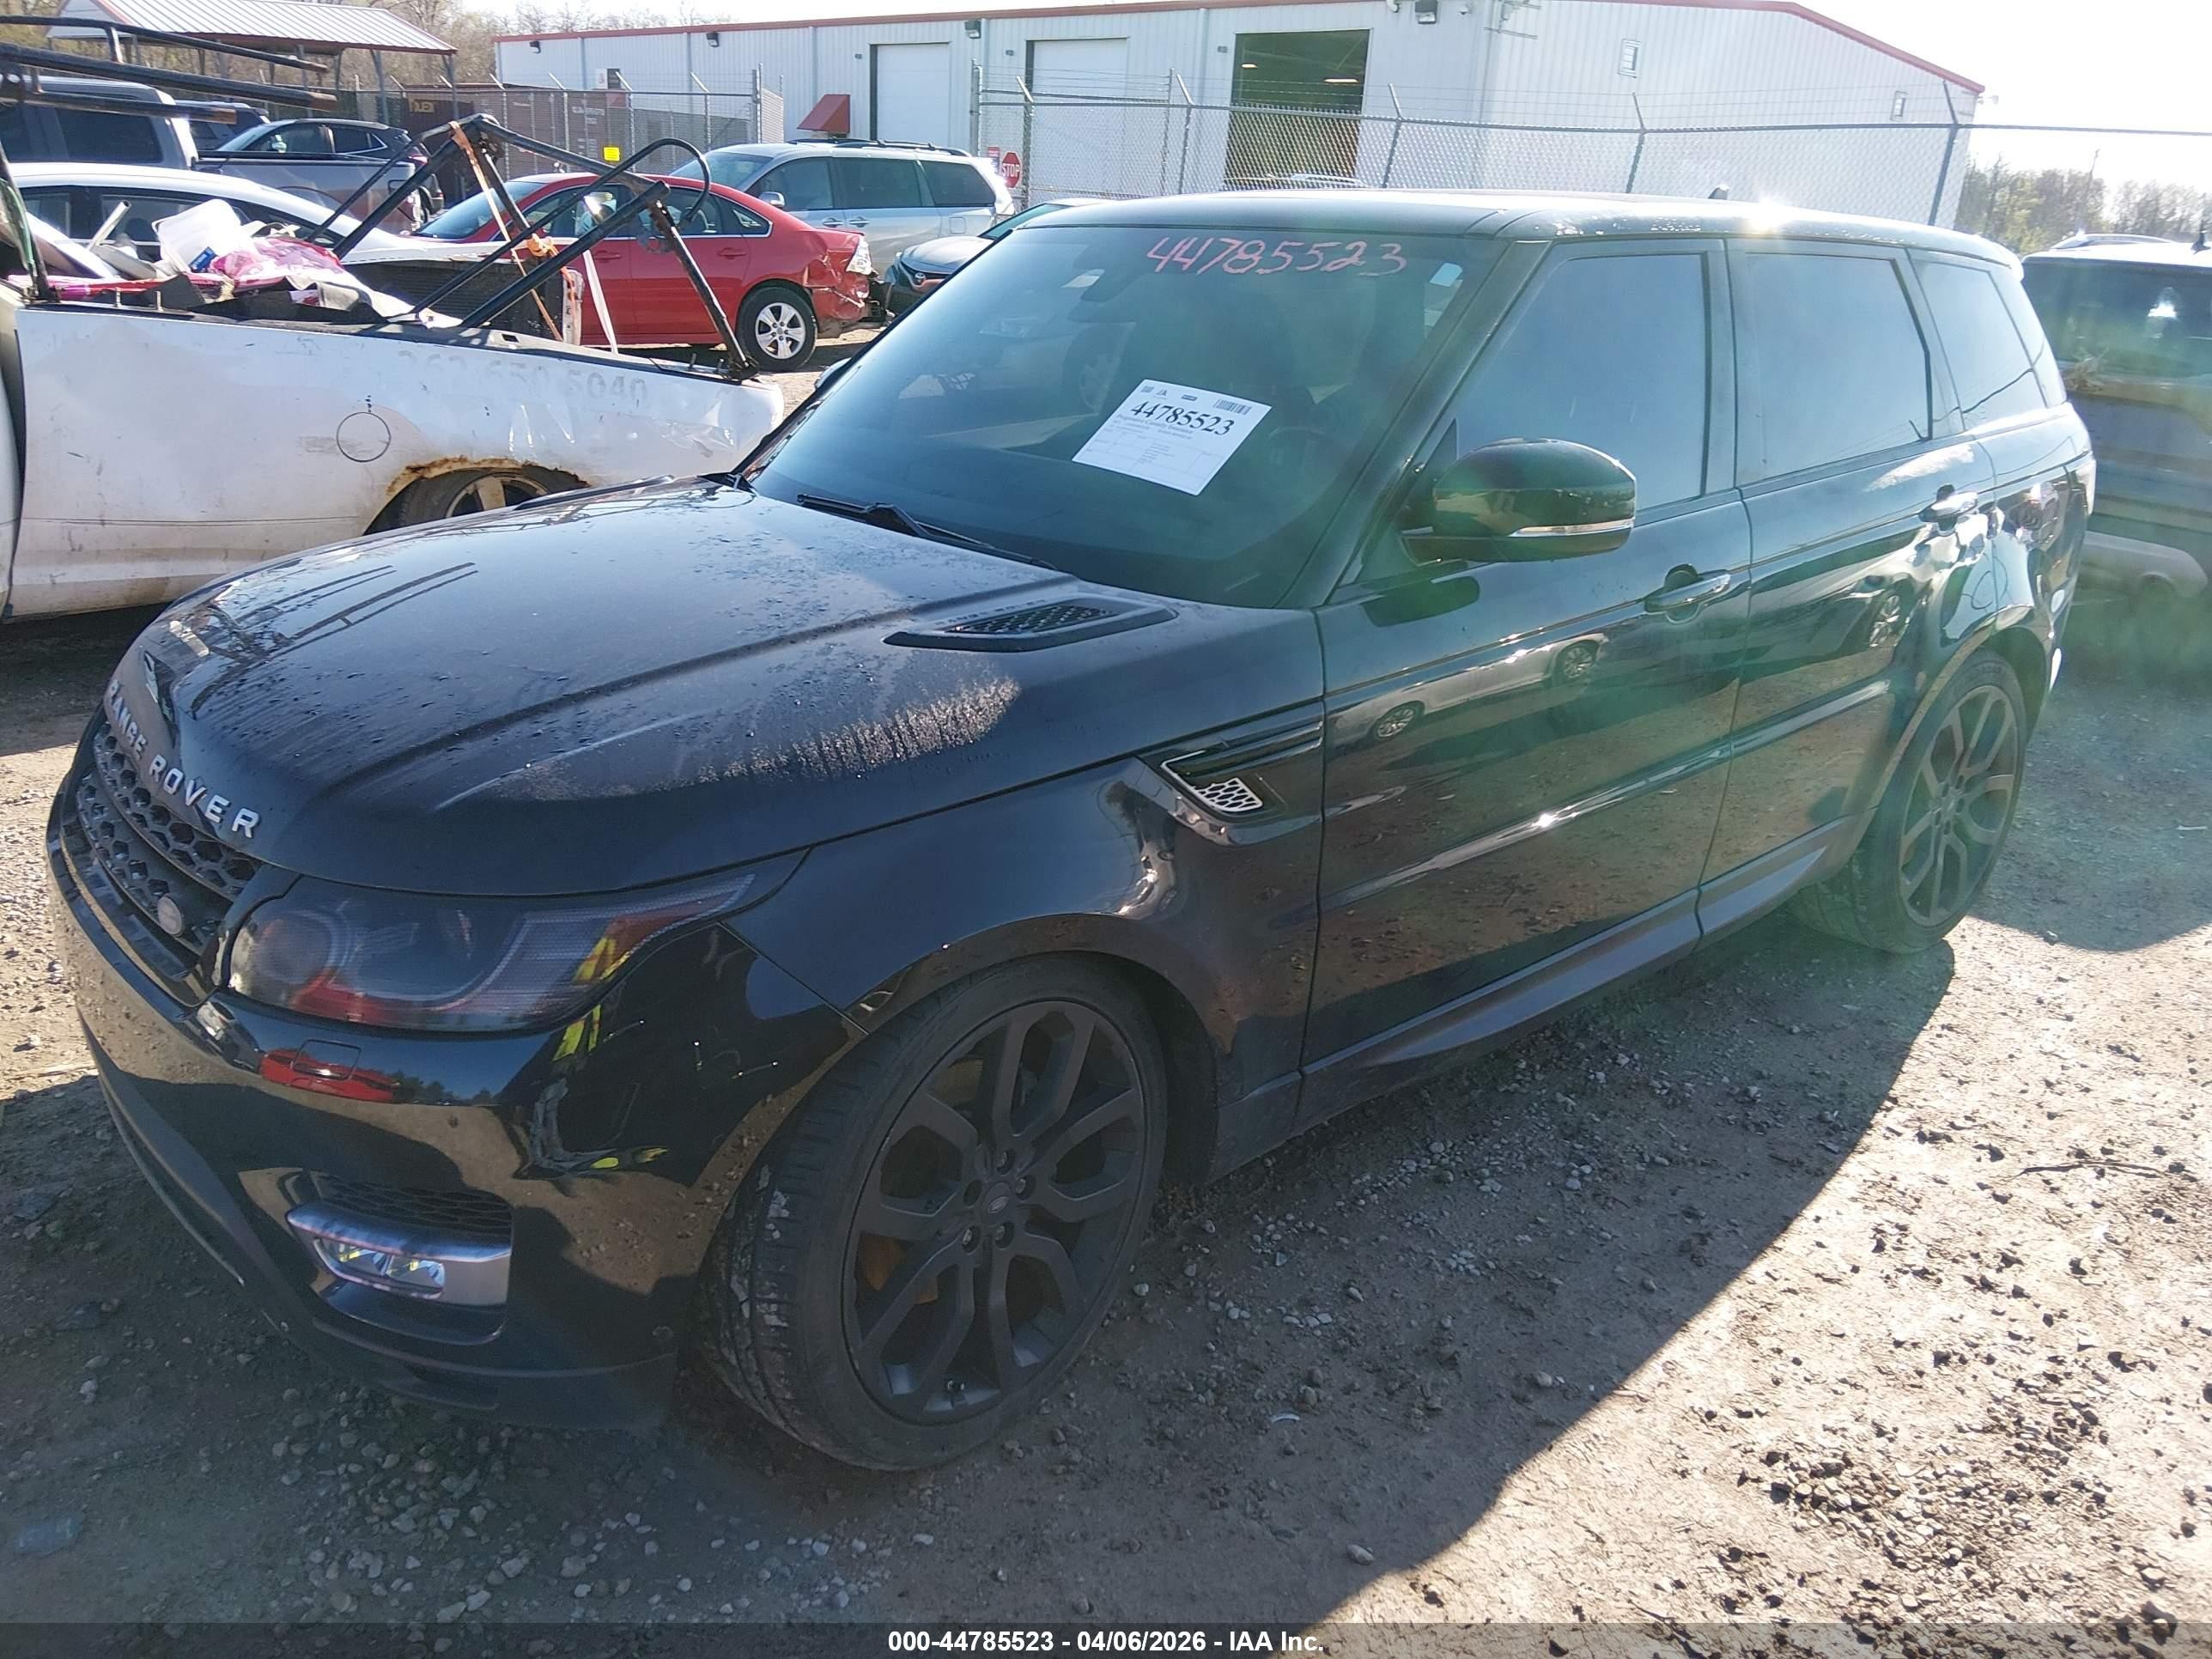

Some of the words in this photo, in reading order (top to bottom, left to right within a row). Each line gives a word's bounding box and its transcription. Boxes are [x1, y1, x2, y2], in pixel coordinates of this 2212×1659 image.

[1002, 163, 1020, 177] STOP
[1147, 237, 1407, 276] 44785523
[1131, 400, 1235, 436] 44785523
[149, 754, 259, 838] ROVER
